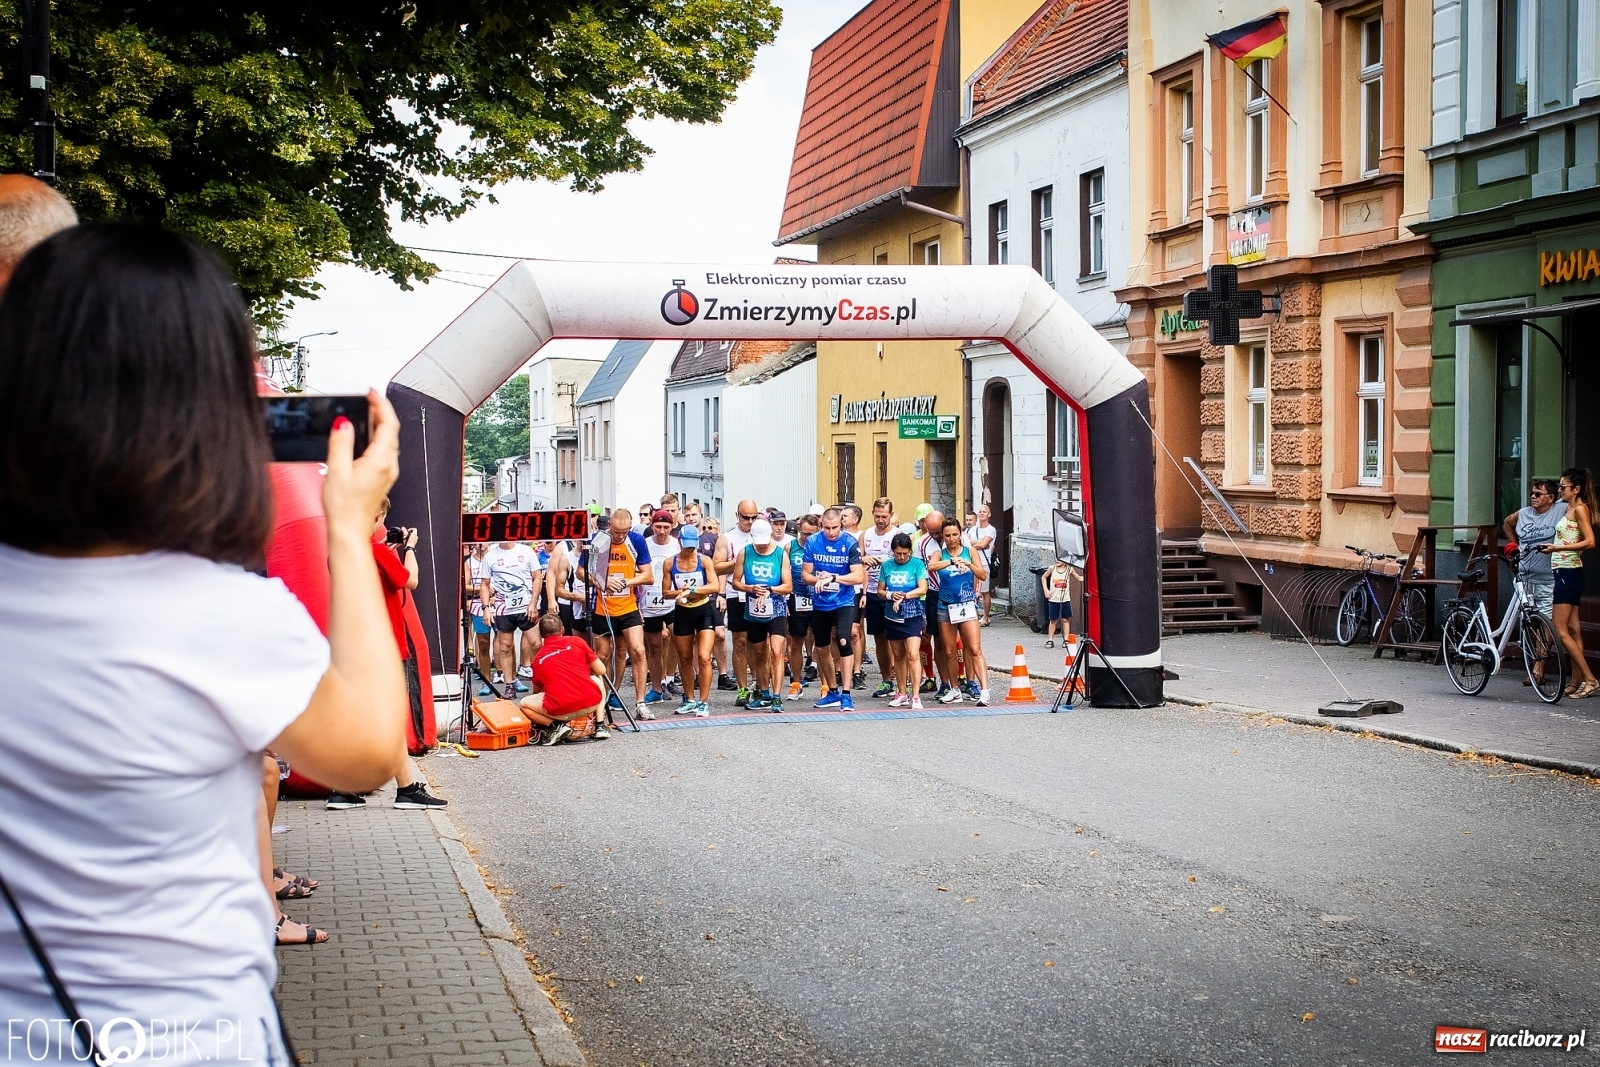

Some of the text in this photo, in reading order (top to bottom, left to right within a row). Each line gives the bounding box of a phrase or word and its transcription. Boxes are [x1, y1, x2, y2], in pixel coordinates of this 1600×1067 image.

[705, 272, 907, 288] Elektroniczny pomiar czasu
[1209, 300, 1243, 310] APTEKA
[702, 297, 918, 327] ZmierzymyCzas.pl
[843, 401, 866, 423] BANK
[902, 418, 937, 426] BANKOMAT
[473, 511, 587, 541] 0 00 00
[812, 553, 850, 564] RUNNERS
[511, 597, 524, 607] 37
[651, 596, 665, 606] 44
[959, 607, 967, 617] 4
